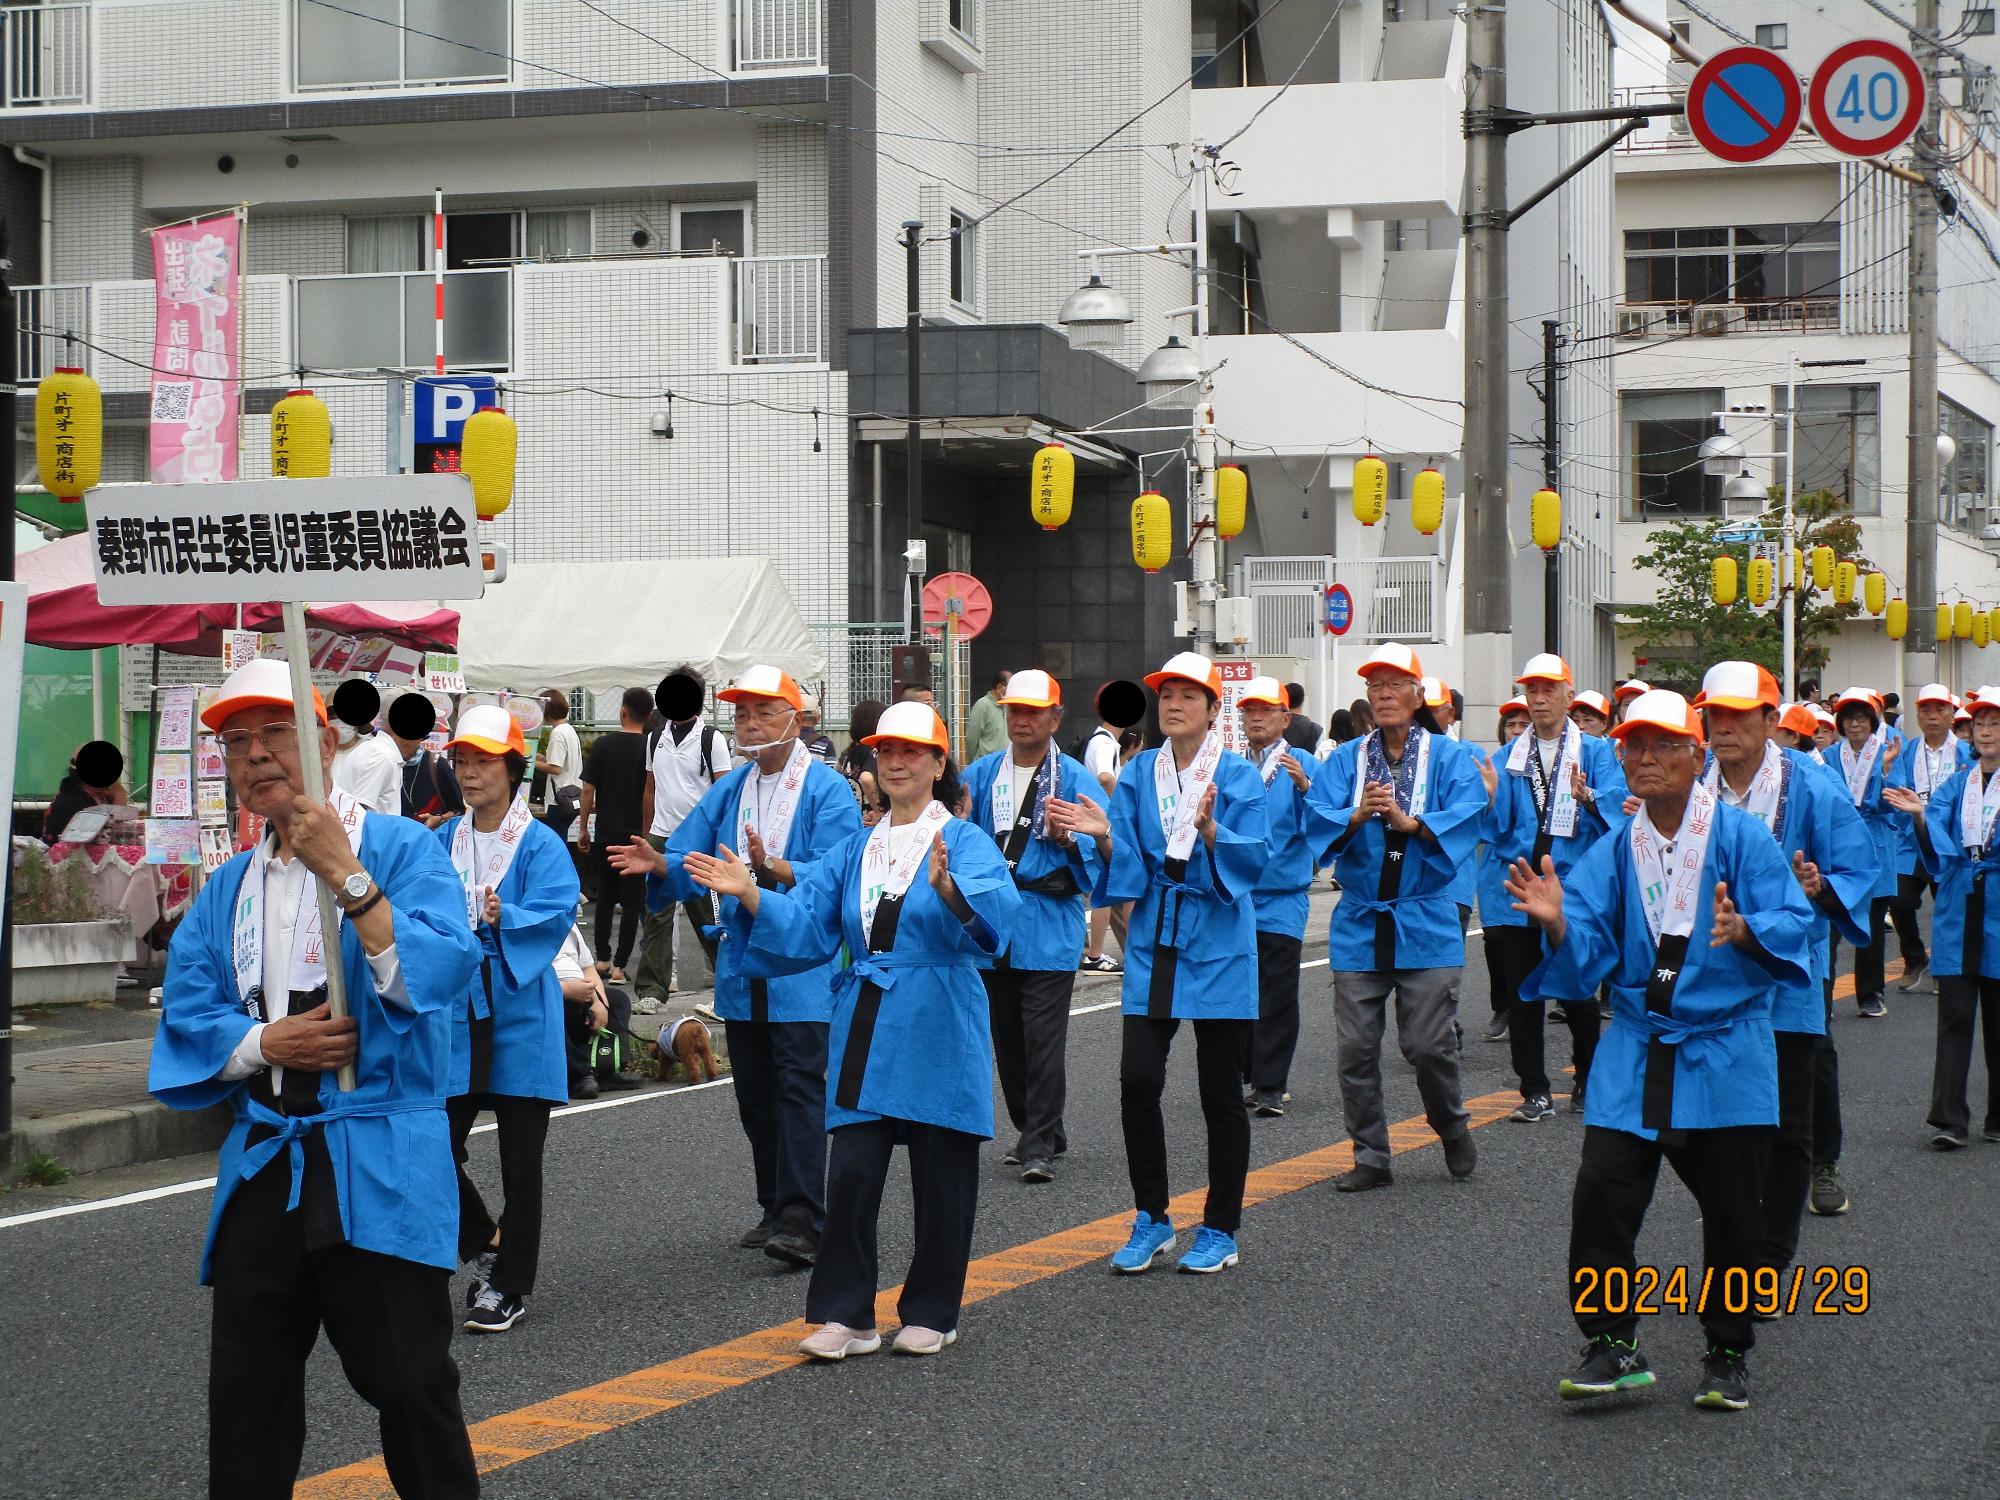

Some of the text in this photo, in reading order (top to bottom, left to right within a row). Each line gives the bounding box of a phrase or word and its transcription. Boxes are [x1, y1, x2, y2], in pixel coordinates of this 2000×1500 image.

[1836, 71, 1898, 124] 40
[433, 383, 476, 438] P
[96, 505, 471, 576] 秦野市民生委員児童委員協議会
[431, 675, 464, 691] せいじ
[996, 784, 1009, 798] JT
[1417, 784, 1425, 795] J
[1161, 793, 1176, 812] JT
[865, 883, 885, 904] JT
[1645, 881, 1663, 906] JT
[238, 894, 256, 928] JT
[1657, 968, 1677, 983] 市
